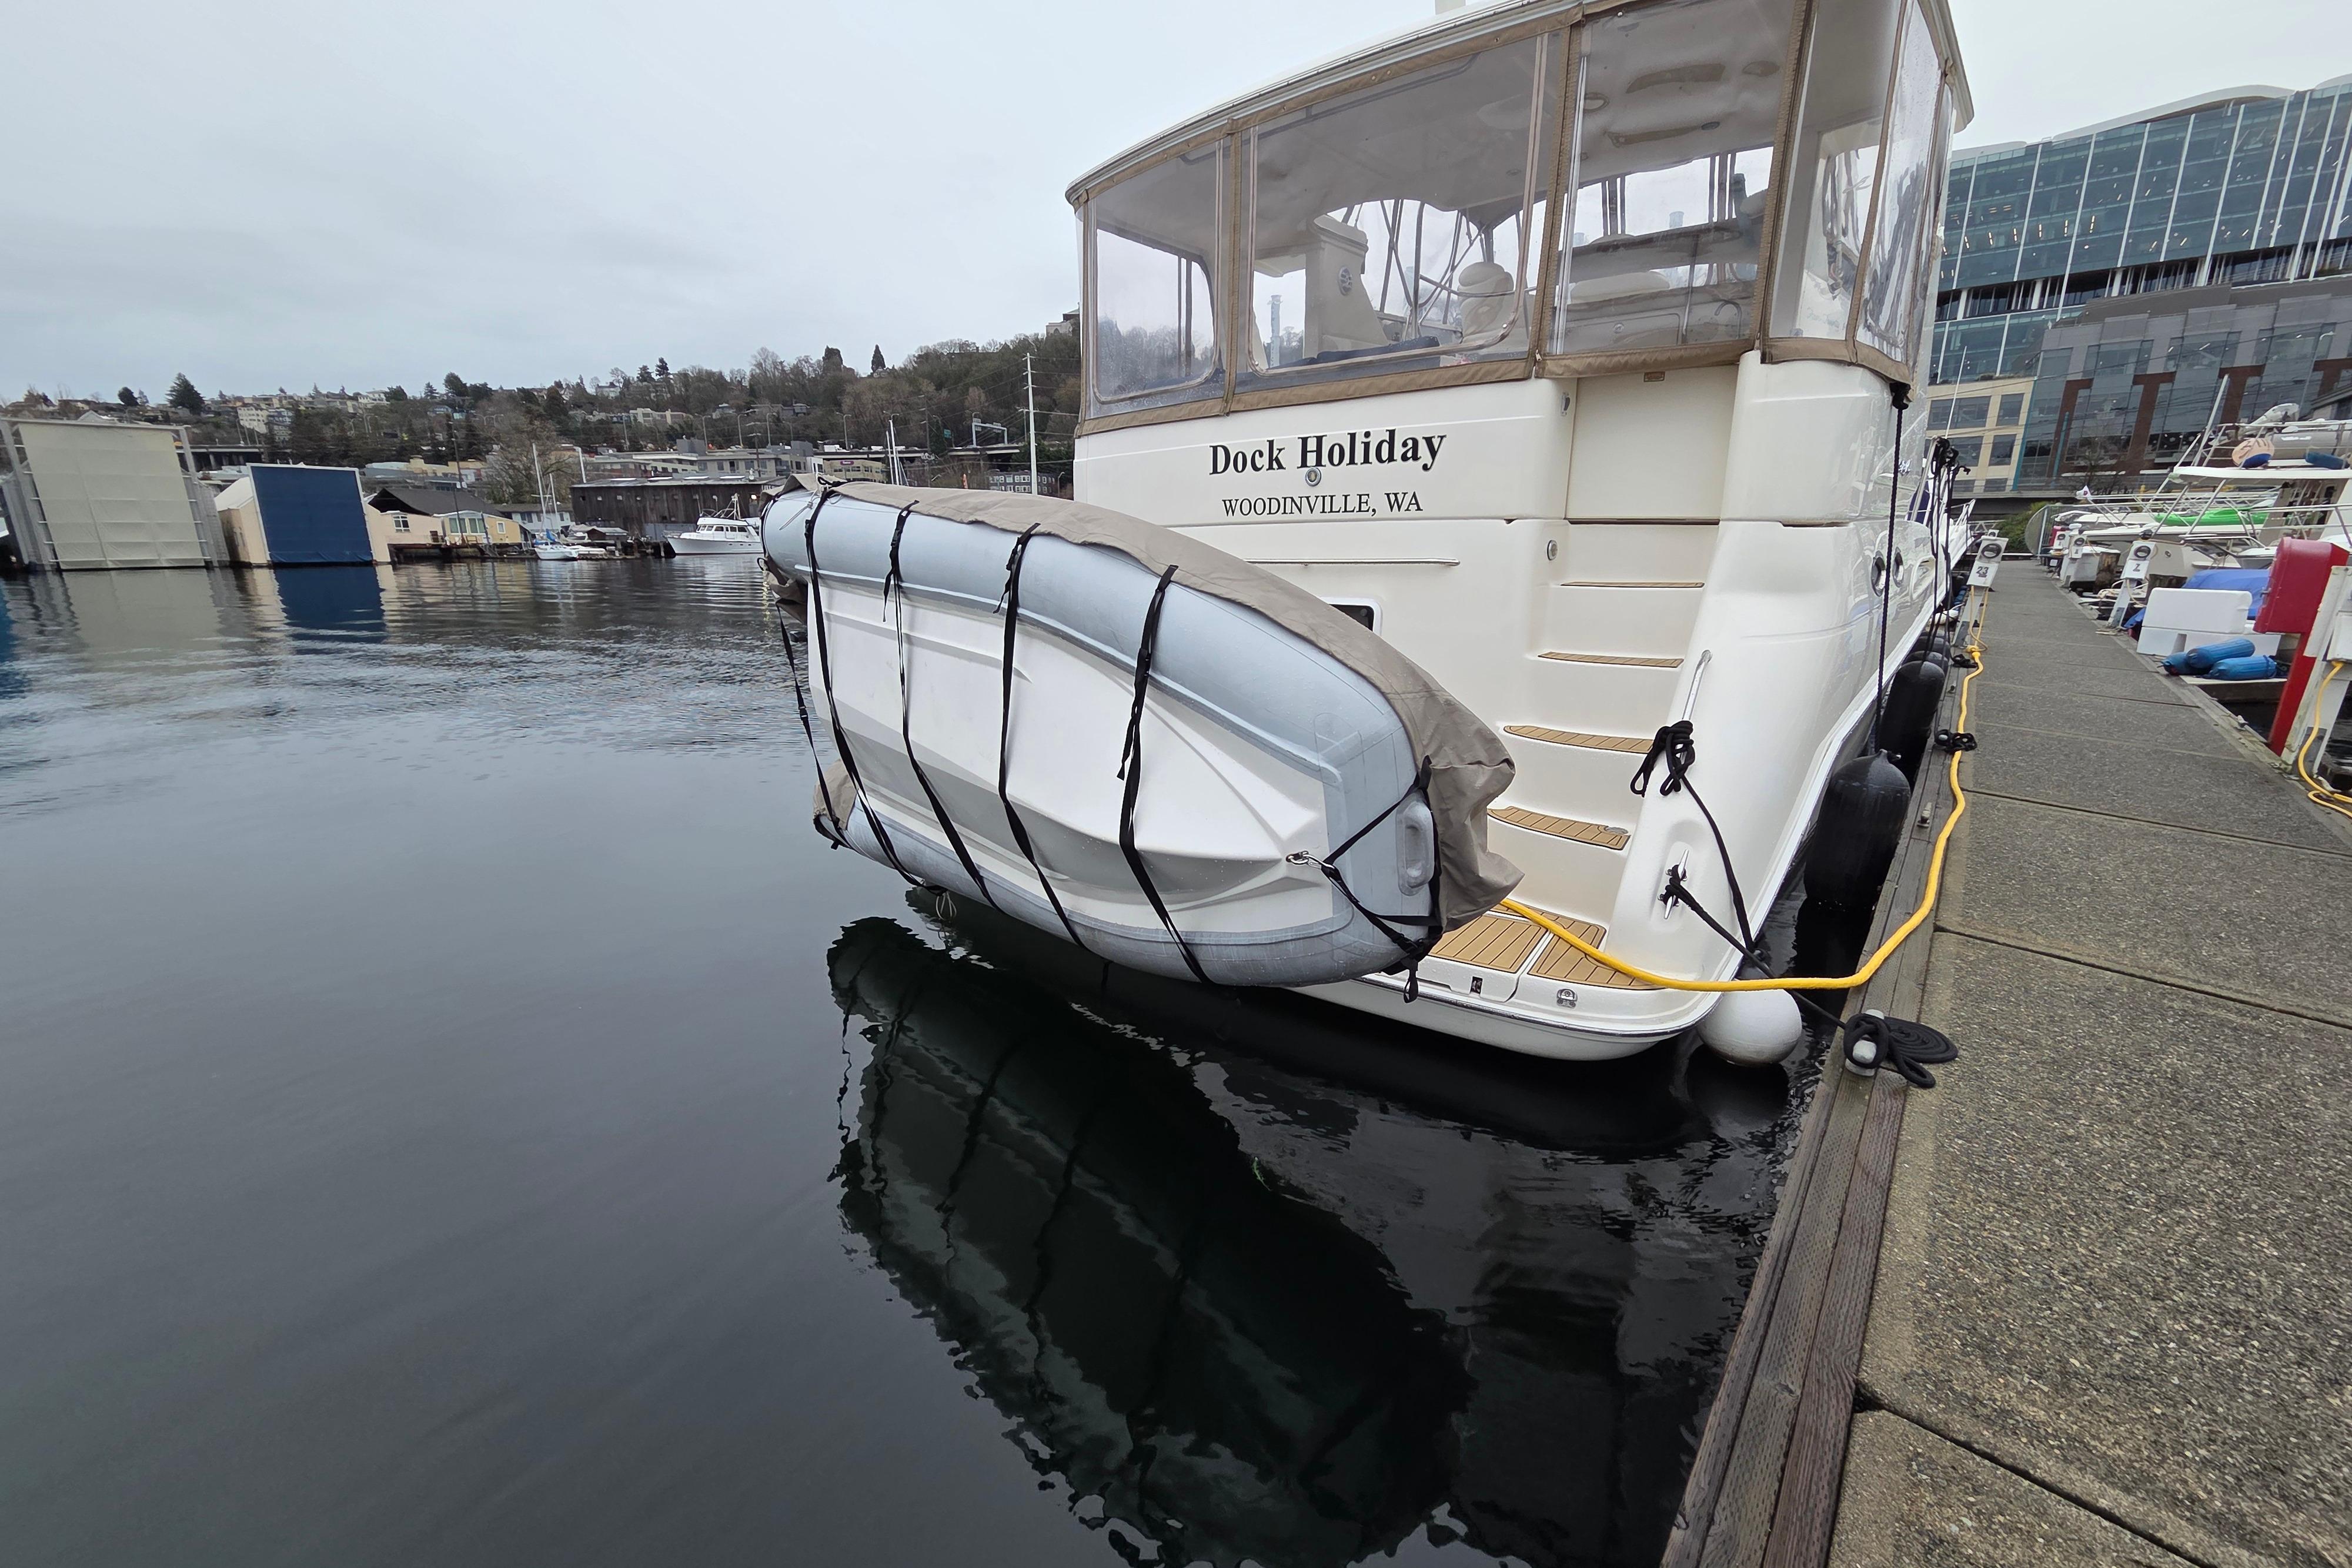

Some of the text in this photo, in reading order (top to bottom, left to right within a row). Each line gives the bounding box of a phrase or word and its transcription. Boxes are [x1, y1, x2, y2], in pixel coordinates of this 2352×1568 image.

[1209, 429, 1446, 475] Dock Holiday
[1222, 492, 1423, 517] WOODINVILLE, WA
[1976, 566, 1989, 575] 23
